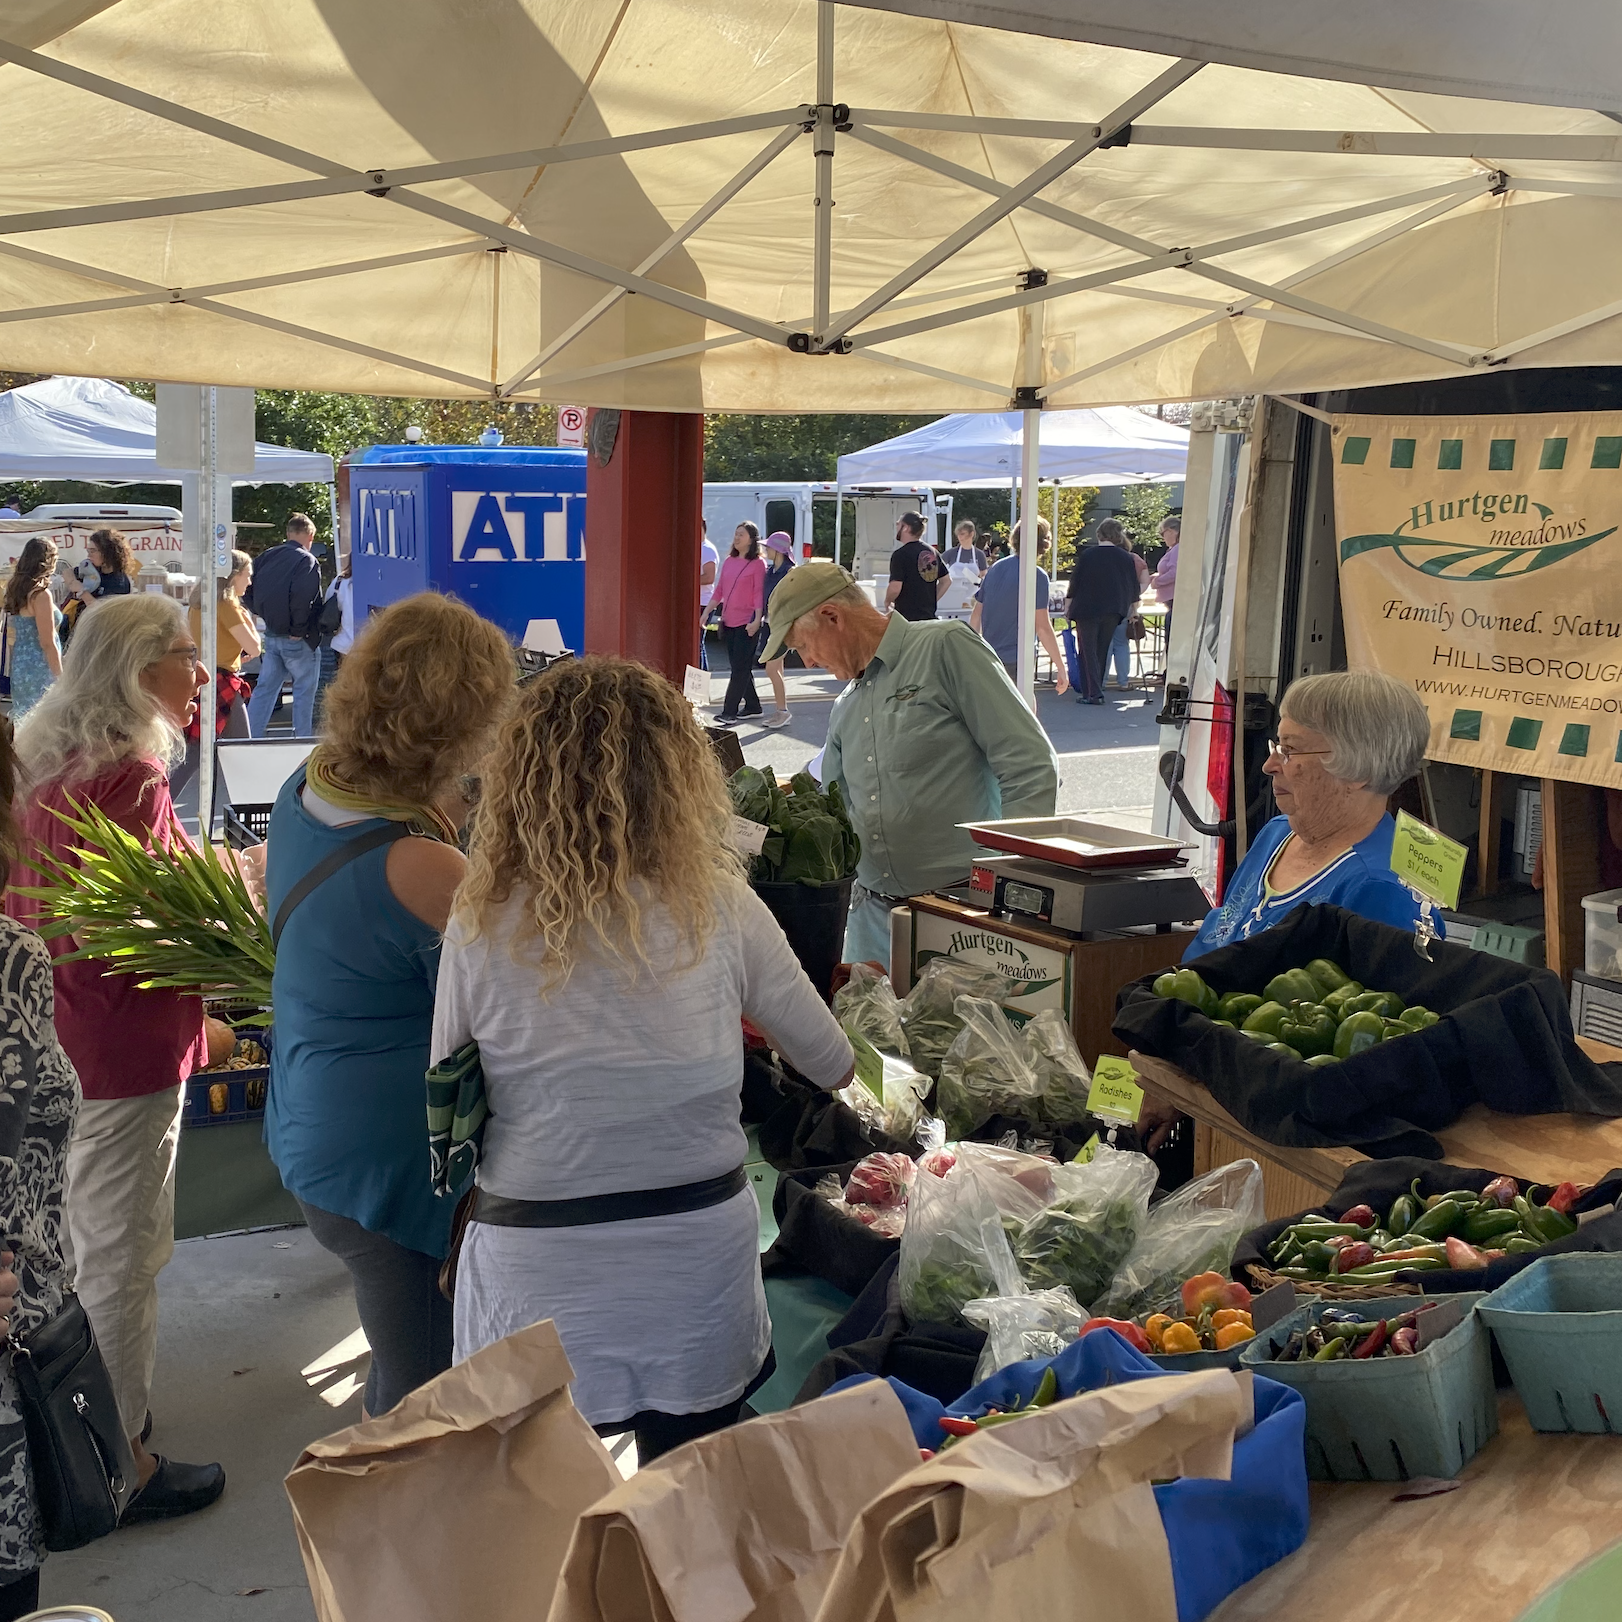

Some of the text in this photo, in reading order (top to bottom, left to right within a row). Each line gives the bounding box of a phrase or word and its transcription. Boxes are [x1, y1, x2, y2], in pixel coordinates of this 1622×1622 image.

[1409, 490, 1529, 531] Hurtgen
[360, 490, 416, 560] ATM
[1489, 518, 1586, 546] meadows
[1382, 600, 1622, 638] Family Owned. Natu
[1415, 679, 1622, 714] WWW.HURTGENMEADO
[1408, 844, 1443, 873] Peppers
[1421, 869, 1440, 886] each
[950, 931, 1014, 956] Hurtgen
[996, 961, 1047, 980] meadows
[1099, 1083, 1133, 1101] Radishes
